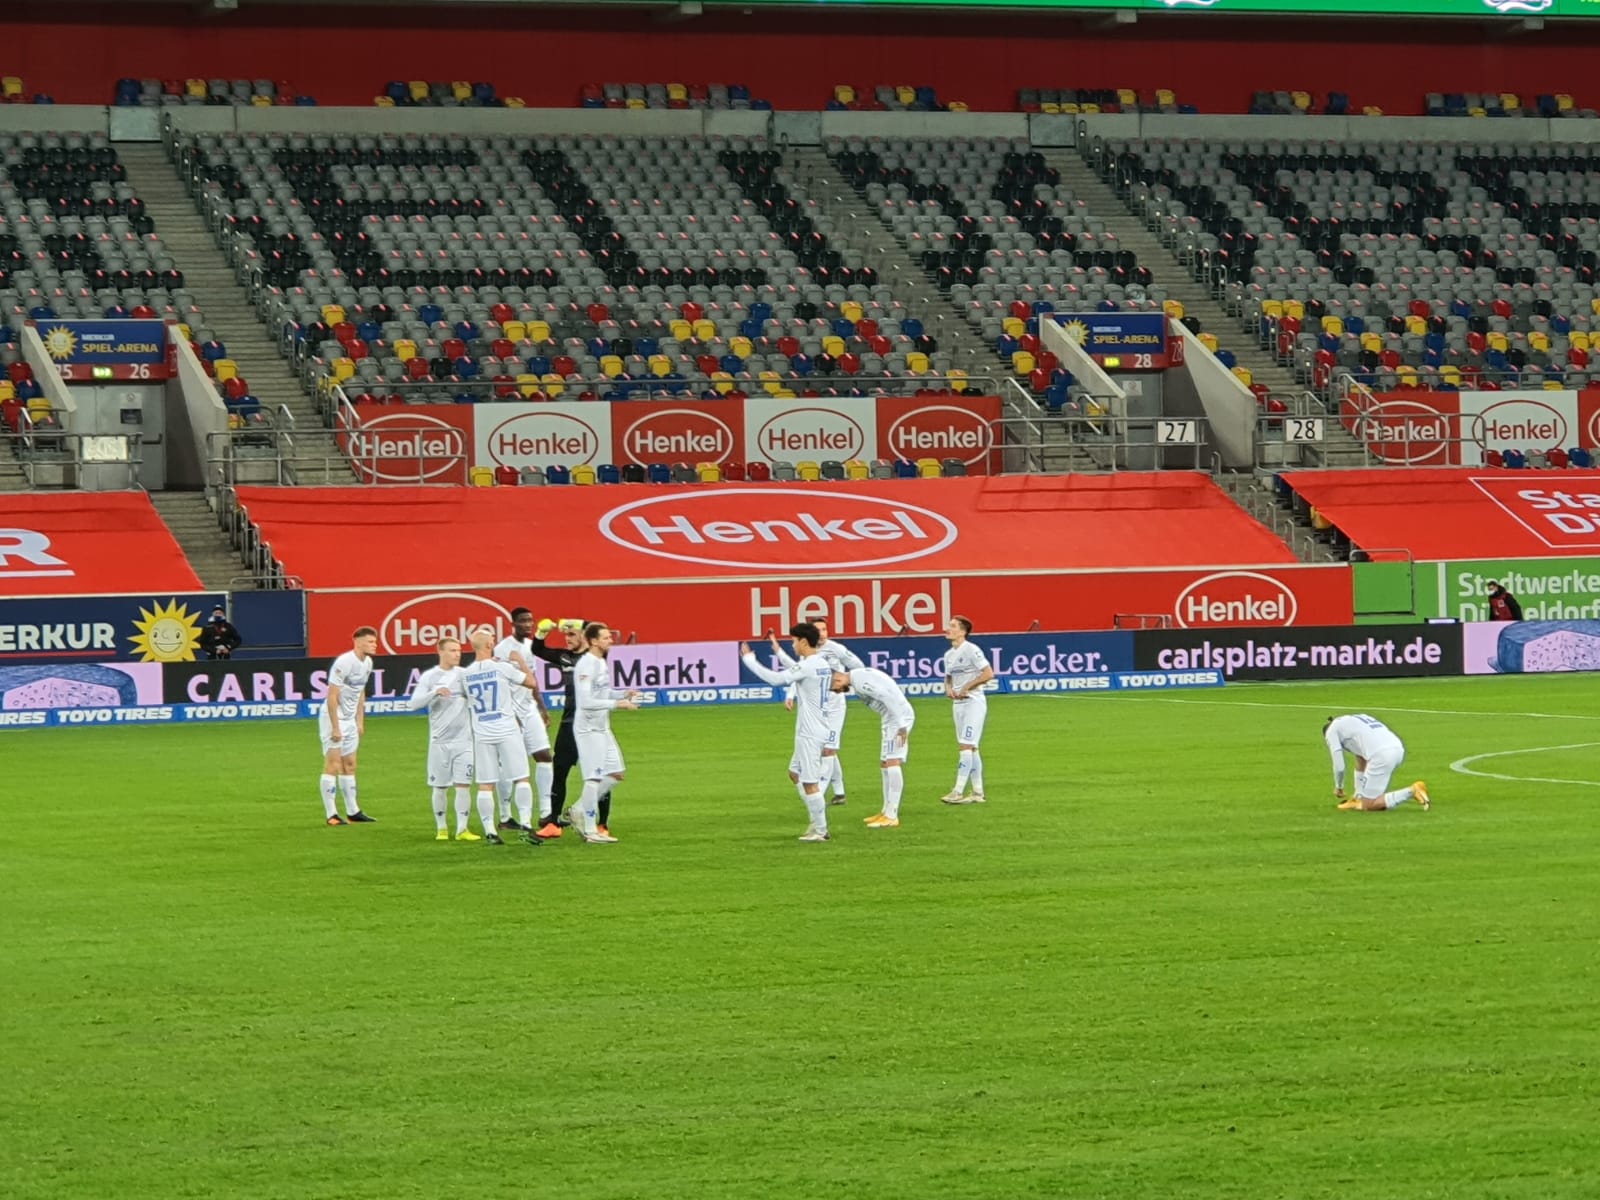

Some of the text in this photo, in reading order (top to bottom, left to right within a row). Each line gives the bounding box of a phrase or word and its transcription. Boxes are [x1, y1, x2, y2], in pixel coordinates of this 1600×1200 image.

[82, 343, 159, 353] SPIEL-ARENA
[1093, 335, 1159, 344] SPIEL-ARENA
[130, 363, 150, 379] 26
[1134, 354, 1152, 368] 28
[768, 427, 853, 451] Henkel
[899, 425, 984, 449] Henkel
[1165, 422, 1188, 441] 27
[1293, 420, 1316, 440] 28
[1362, 420, 1440, 440] Henkel
[361, 434, 451, 457] Henkel
[500, 431, 588, 456] Henkel
[635, 429, 722, 454] Henkel
[630, 511, 928, 544] Henkel
[751, 578, 951, 637] Henkel
[1187, 594, 1285, 622] Henkel
[990, 645, 1108, 676] Lecker.
[1158, 637, 1442, 675] carlsplatz-markt.de
[613, 656, 716, 688] Markt.
[1120, 671, 1218, 686] TOYO TIRES
[1010, 679, 1058, 691] TOYO
[1060, 675, 1110, 689] TIRES
[468, 681, 497, 713] 37
[667, 690, 718, 704] TOYO
[720, 687, 773, 701] TIRES
[58, 706, 173, 723] TOYO TIRES
[184, 706, 238, 719] TOYO
[242, 703, 297, 717] TIRES
